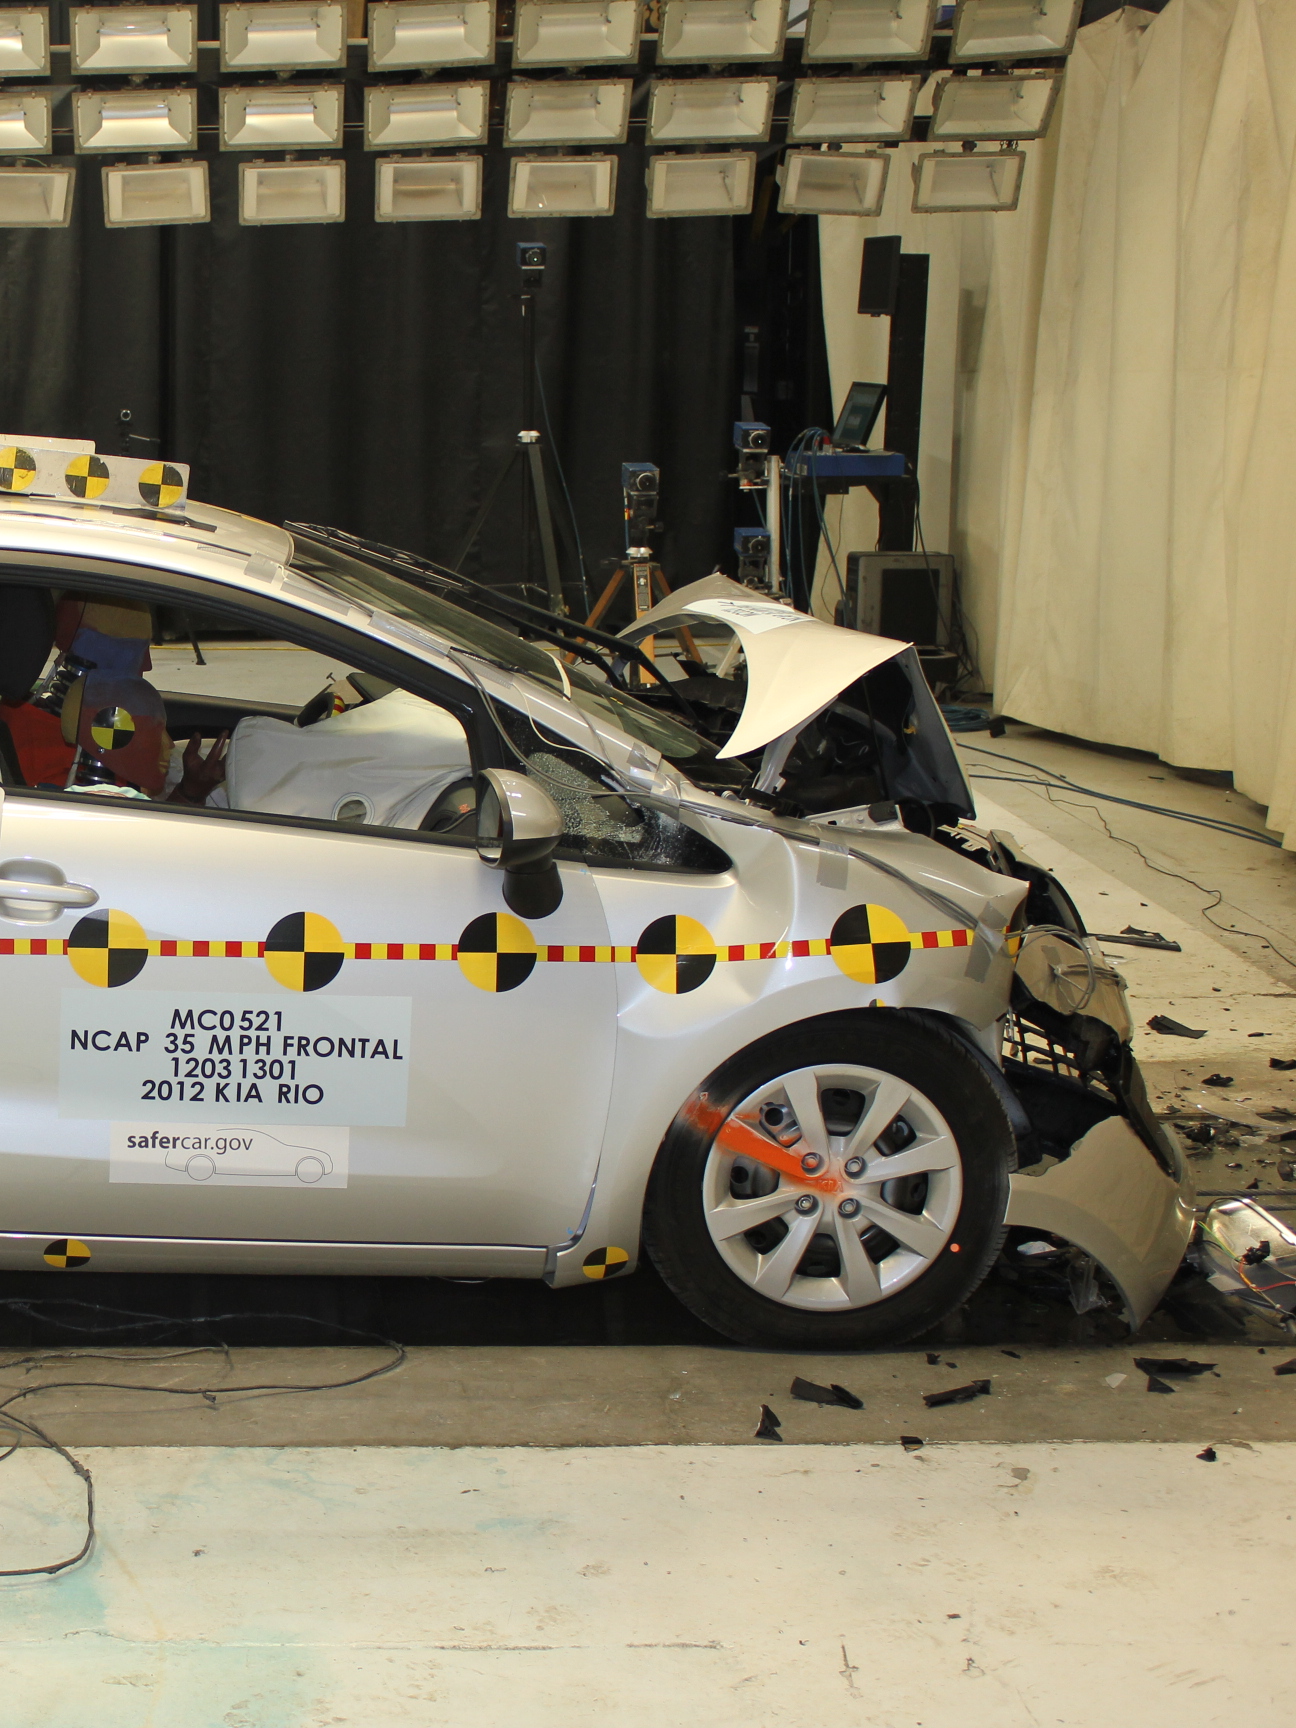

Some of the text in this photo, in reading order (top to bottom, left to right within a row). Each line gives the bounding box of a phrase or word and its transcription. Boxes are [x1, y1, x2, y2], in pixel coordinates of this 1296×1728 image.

[170, 1008, 283, 1032] MC0521
[70, 1030, 403, 1060] NCAP 35 MPH FRONTAL
[171, 1057, 297, 1080] 12031301
[140, 1079, 325, 1105] 2012 KIA RIO
[127, 1130, 253, 1155] safercar.gov
